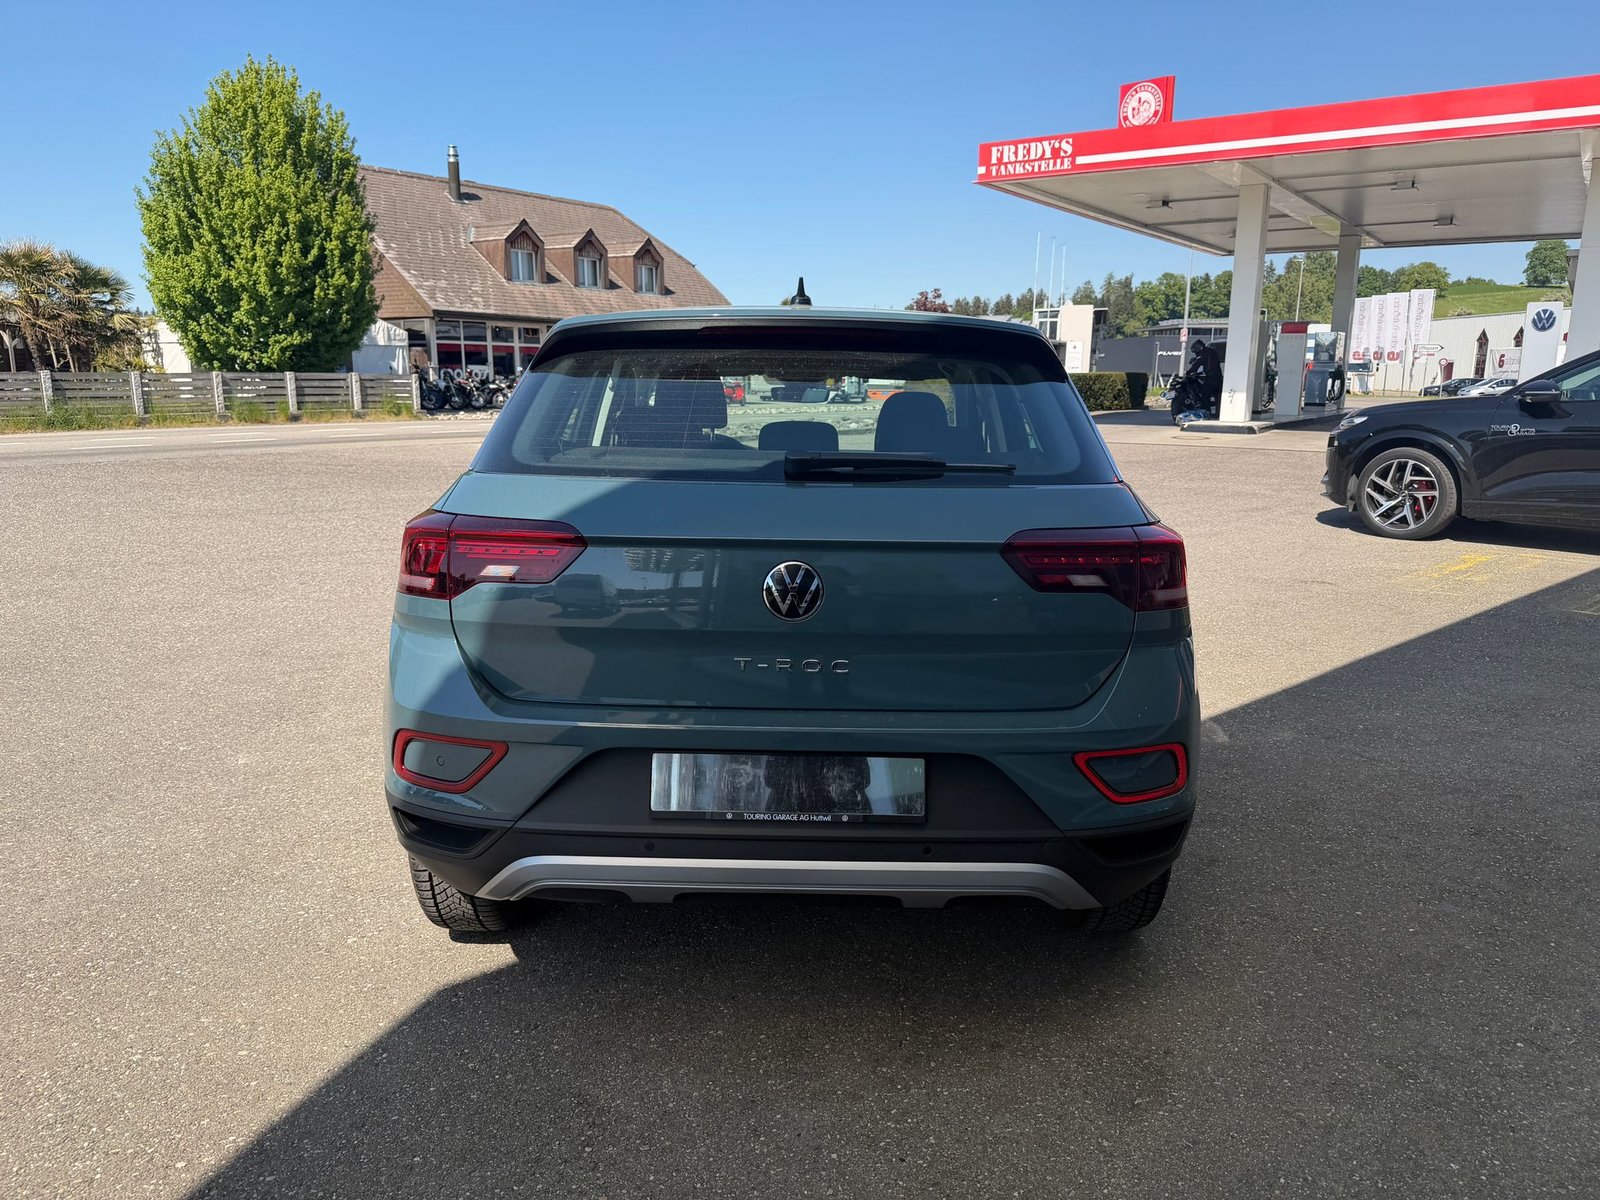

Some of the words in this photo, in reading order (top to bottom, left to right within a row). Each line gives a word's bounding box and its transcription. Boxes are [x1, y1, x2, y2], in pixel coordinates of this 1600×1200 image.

[990, 157, 1072, 177] TANKSTELLE
[734, 657, 849, 673] T-ROC
[743, 812, 772, 820] TOURING
[772, 813, 798, 821] GARAGE
